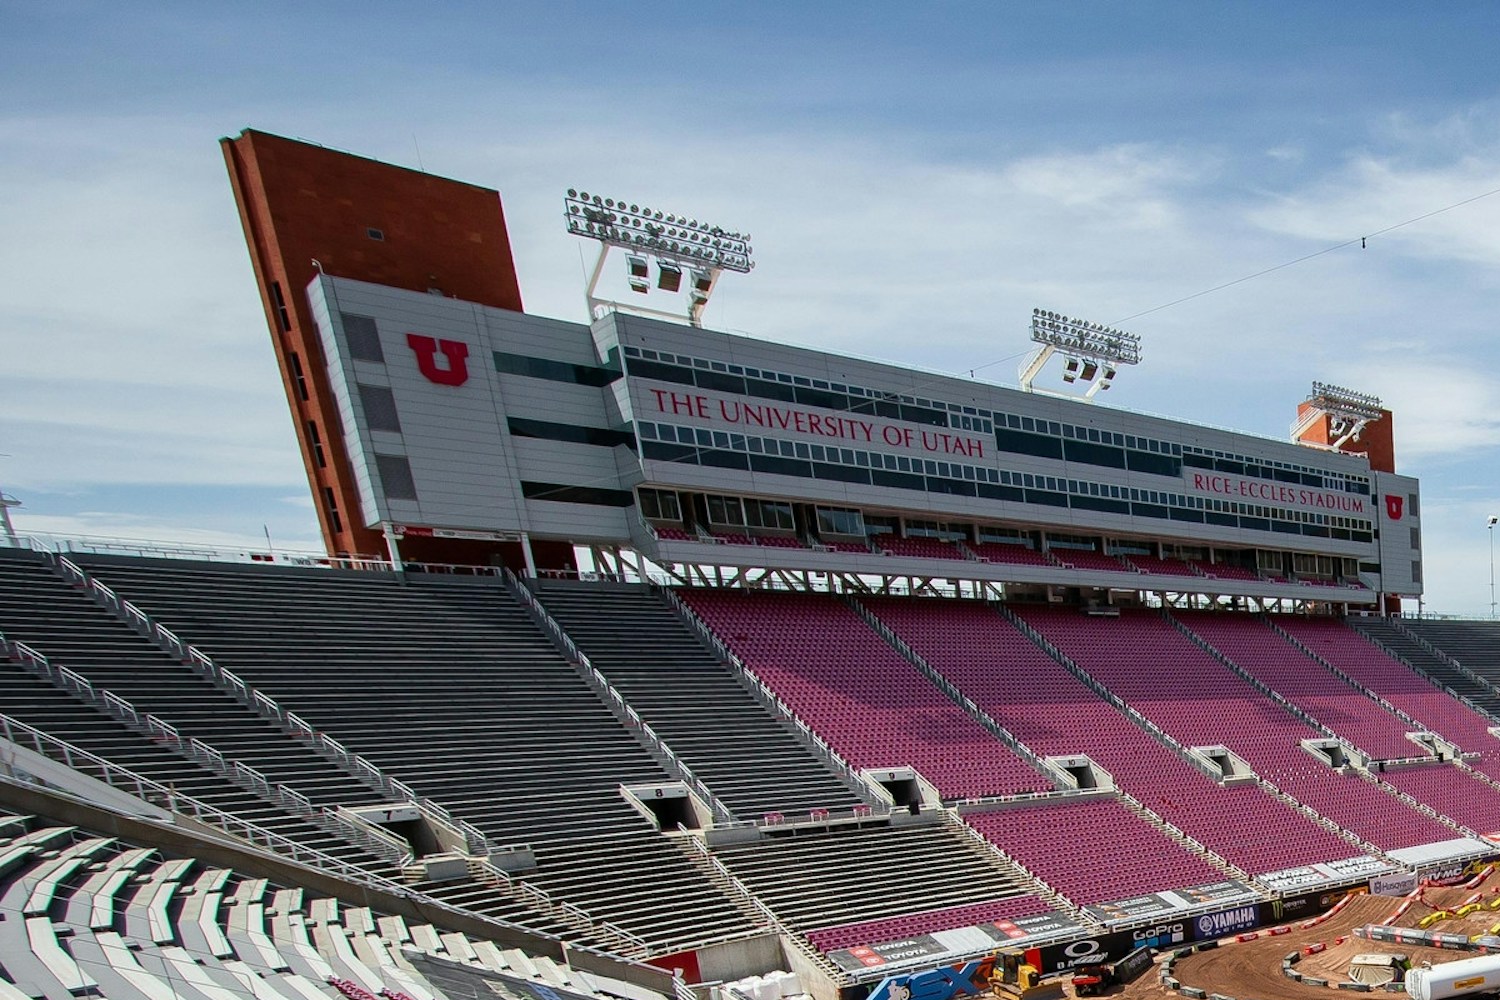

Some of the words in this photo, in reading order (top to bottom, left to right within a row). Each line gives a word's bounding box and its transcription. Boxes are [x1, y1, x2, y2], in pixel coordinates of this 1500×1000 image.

[405, 333, 469, 387] U
[650, 388, 711, 420] THE
[719, 399, 874, 443] UNIVERSITY
[883, 424, 915, 449] OF
[921, 430, 984, 458] UTAH
[1194, 473, 1295, 503] RICE-ECCLES
[1299, 489, 1363, 512] STADIUM
[1385, 494, 1403, 521] U
[1026, 922, 1062, 934] TOYOTA
[1211, 906, 1255, 928] YAMAHA
[1132, 922, 1184, 941] GoPro
[873, 940, 917, 951] TOYOTA
[884, 947, 927, 961] TOYOTA
